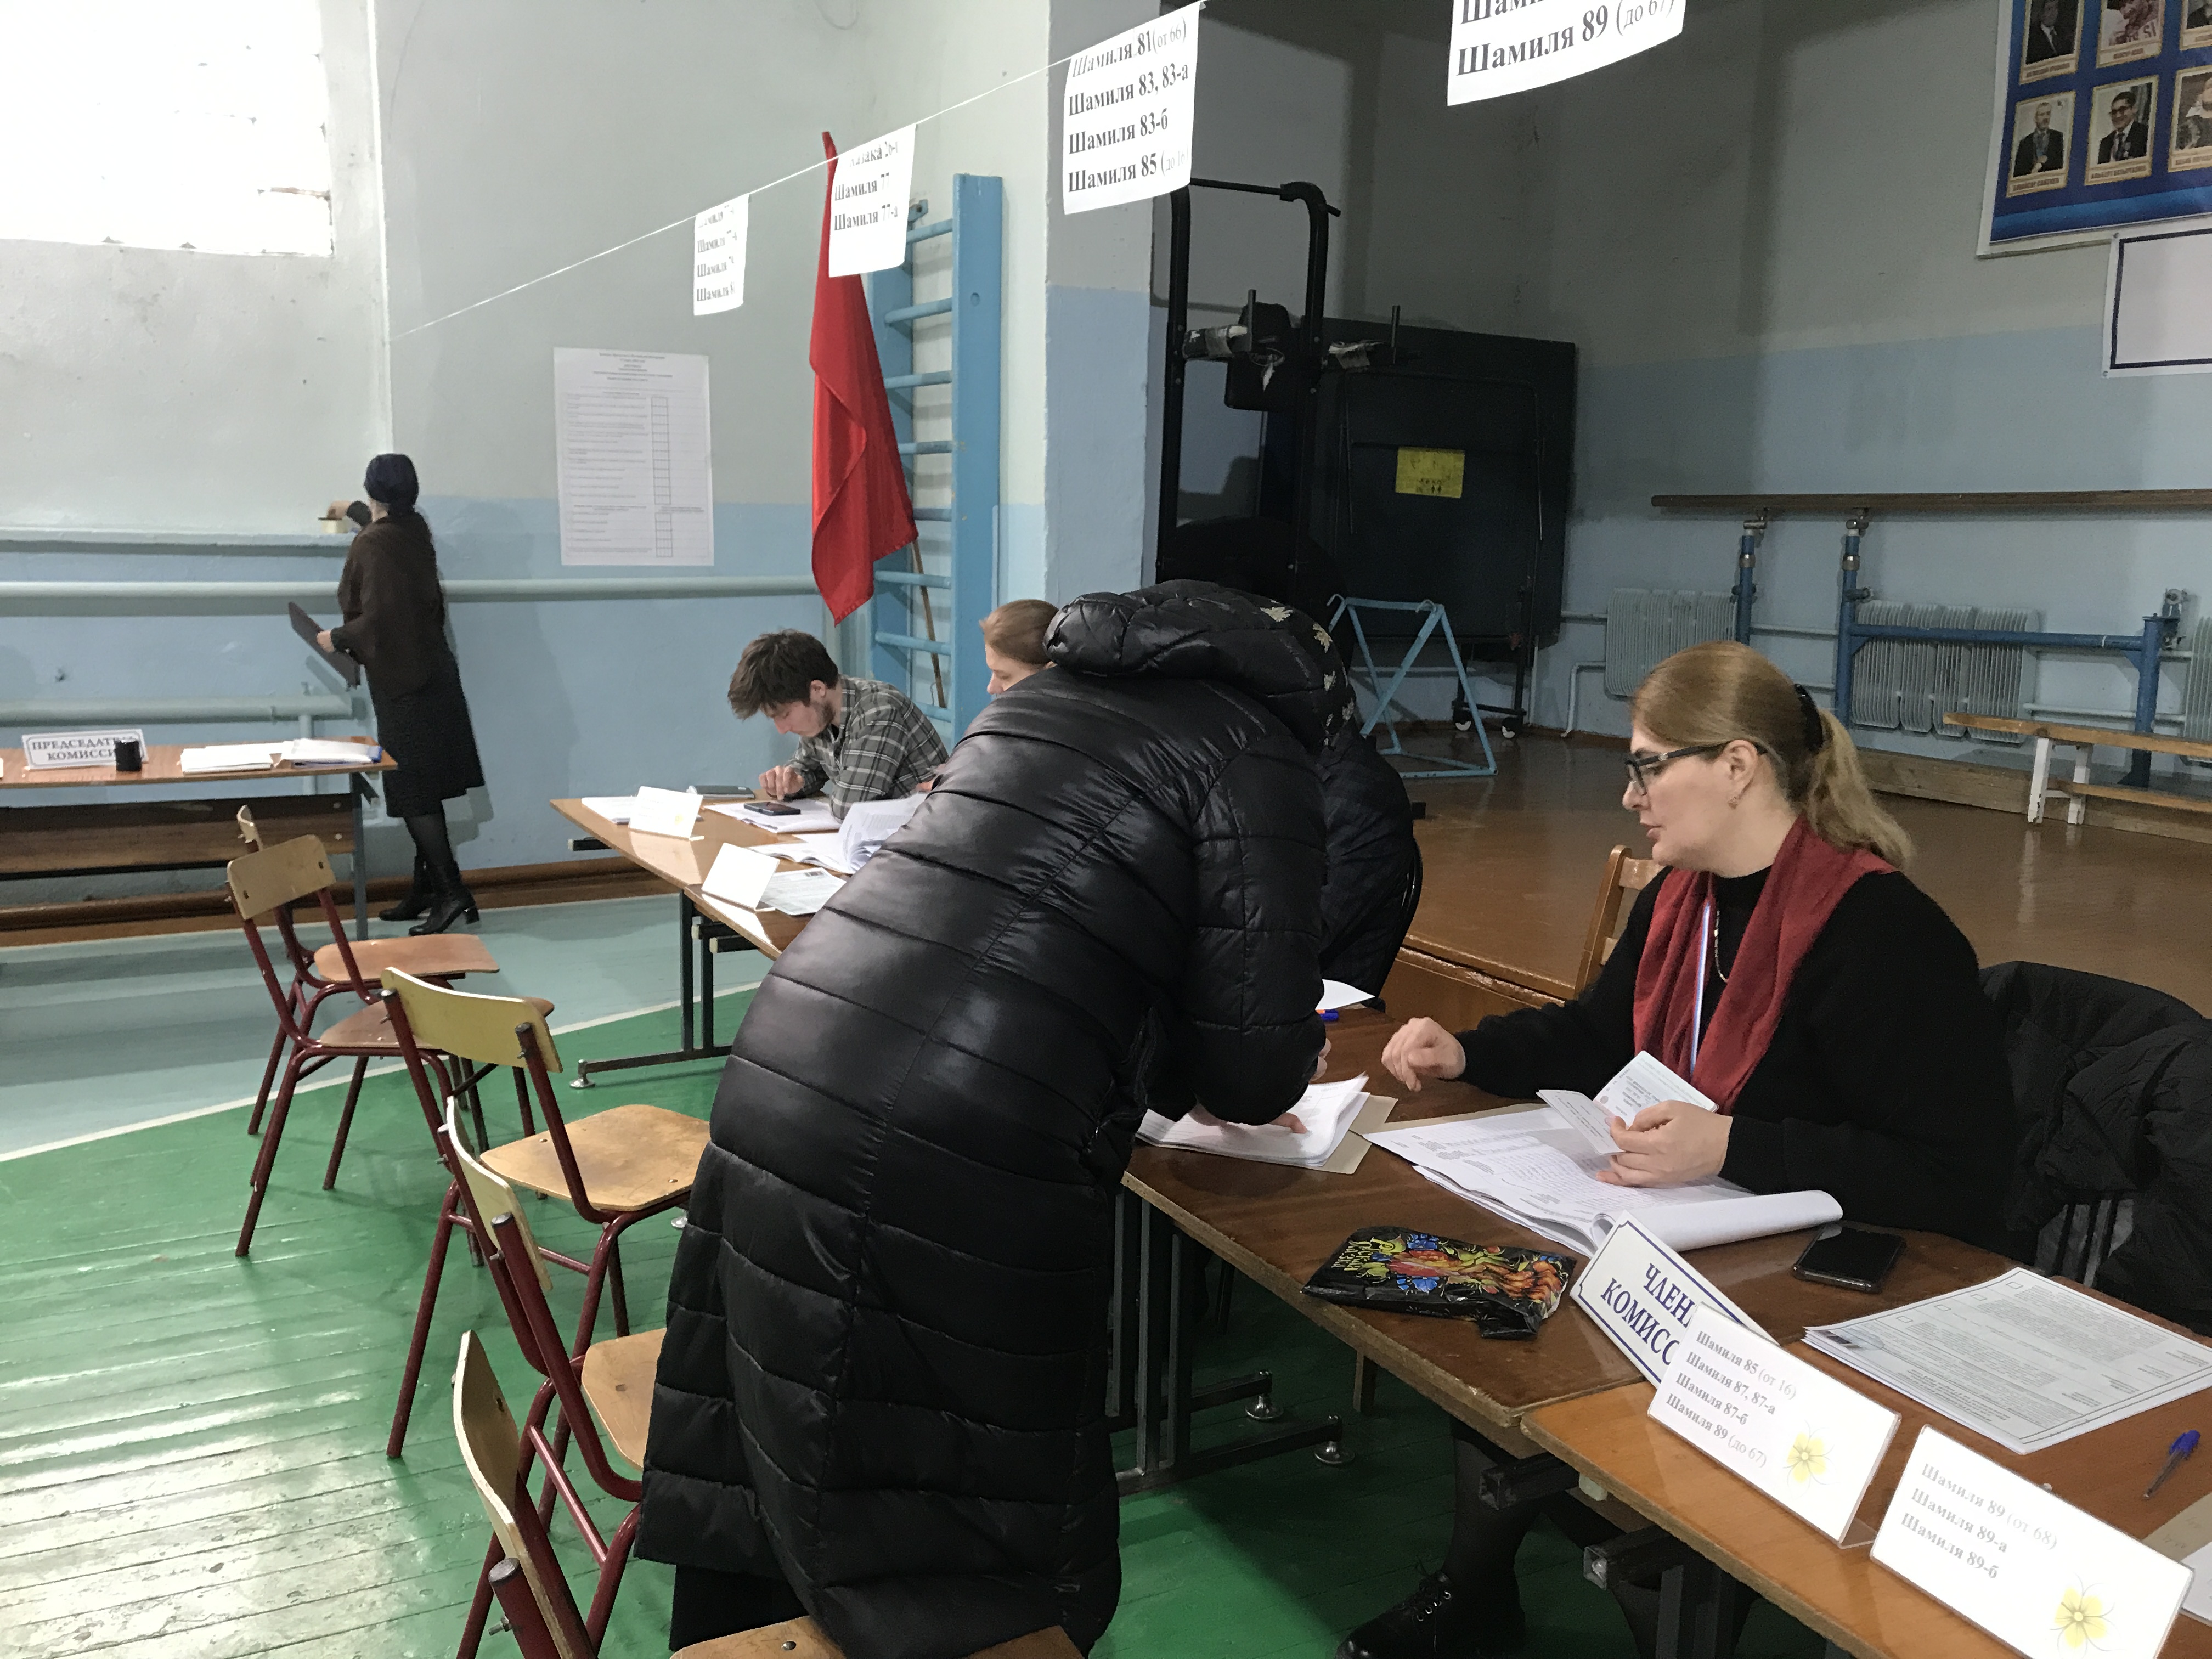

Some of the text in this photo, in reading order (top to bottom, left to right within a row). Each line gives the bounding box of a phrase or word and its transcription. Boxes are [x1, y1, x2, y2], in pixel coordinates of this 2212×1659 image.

[1072, 43, 1132, 77] Шамиля
[1170, 16, 1186, 43] 66)
[1456, 26, 1575, 76] Шамиля
[1582, 5, 1609, 41] 89
[1069, 63, 1188, 116] Шамиля 83, 83-а
[1069, 108, 1168, 154] Шамиля 83-б
[834, 180, 877, 201] Шамиля
[1068, 164, 1136, 192] Шамиля
[1141, 153, 1157, 177] 85
[834, 211, 878, 230] Шамиля
[32, 737, 133, 749] ПРЕДСЕДАТ
[1601, 1278, 1680, 1365] КОМИСС
[1644, 1263, 1696, 1328] ЧЛЕН
[1686, 1352, 1776, 1415] Шамиля 87, 87-а
[1696, 1331, 1797, 1400] Шамиля 85 (от 16)
[1666, 1393, 1767, 1468] Шамиля 89 (до 67)
[1675, 1373, 1749, 1425] Шамиля 87-б
[1911, 1488, 2008, 1553] Шамиля 89-а
[1921, 1463, 2058, 1550] Шамиля 89 (от 68)
[1901, 1513, 2000, 1579] Шамиля 89-б
